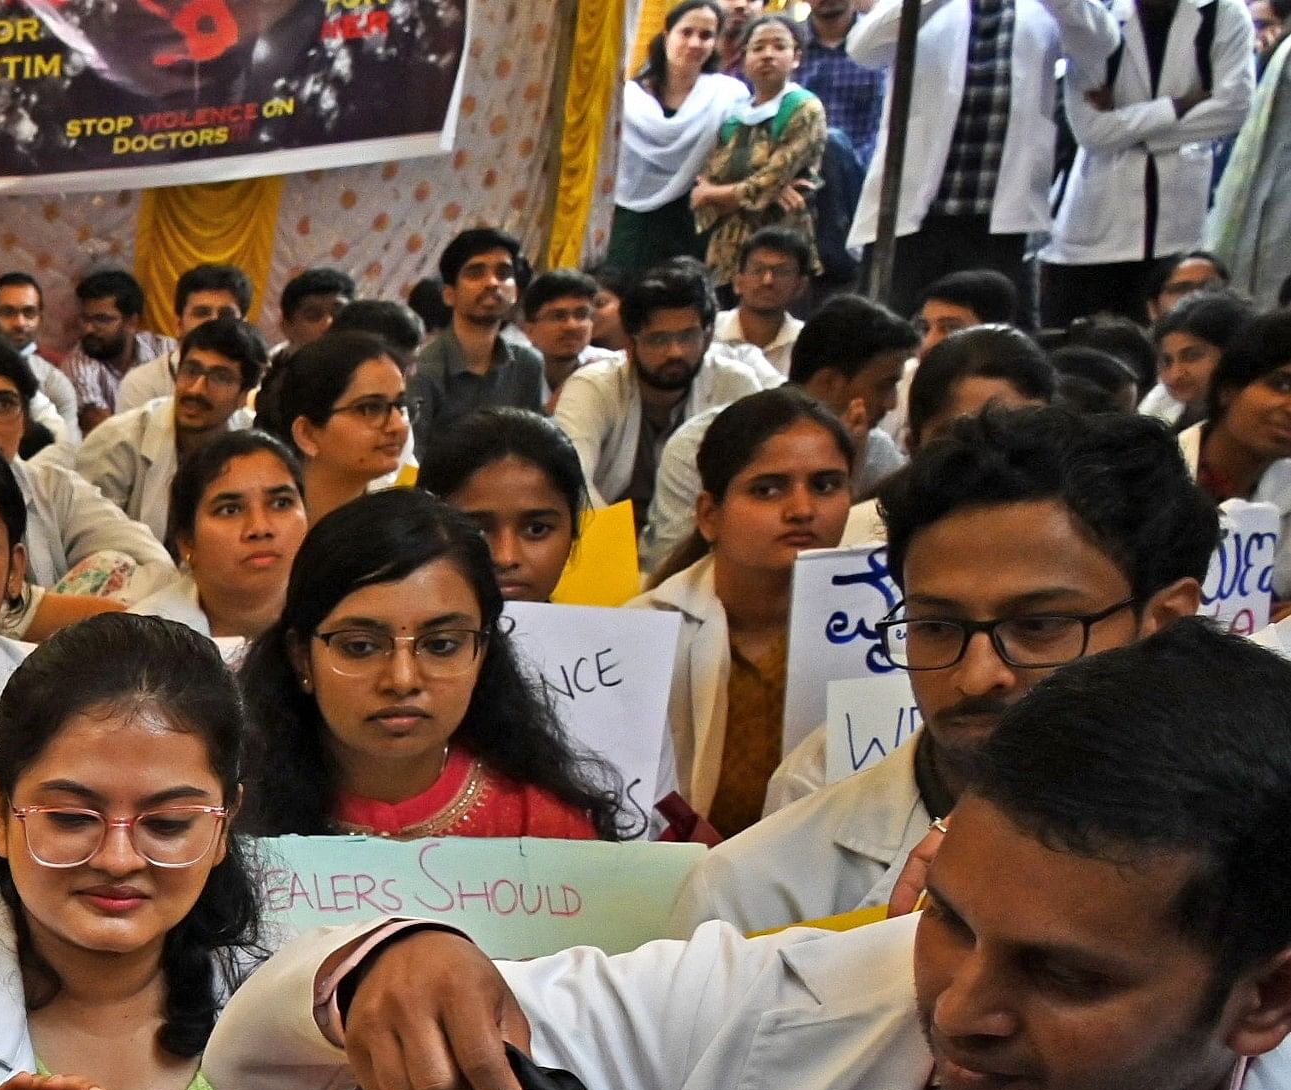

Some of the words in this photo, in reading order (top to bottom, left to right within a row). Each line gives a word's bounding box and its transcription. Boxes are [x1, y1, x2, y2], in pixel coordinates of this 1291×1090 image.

[66, 116, 134, 138] STOP
[138, 102, 259, 131] VIOLENCE
[262, 96, 295, 119] ON
[414, 842, 584, 917] SHOULD
